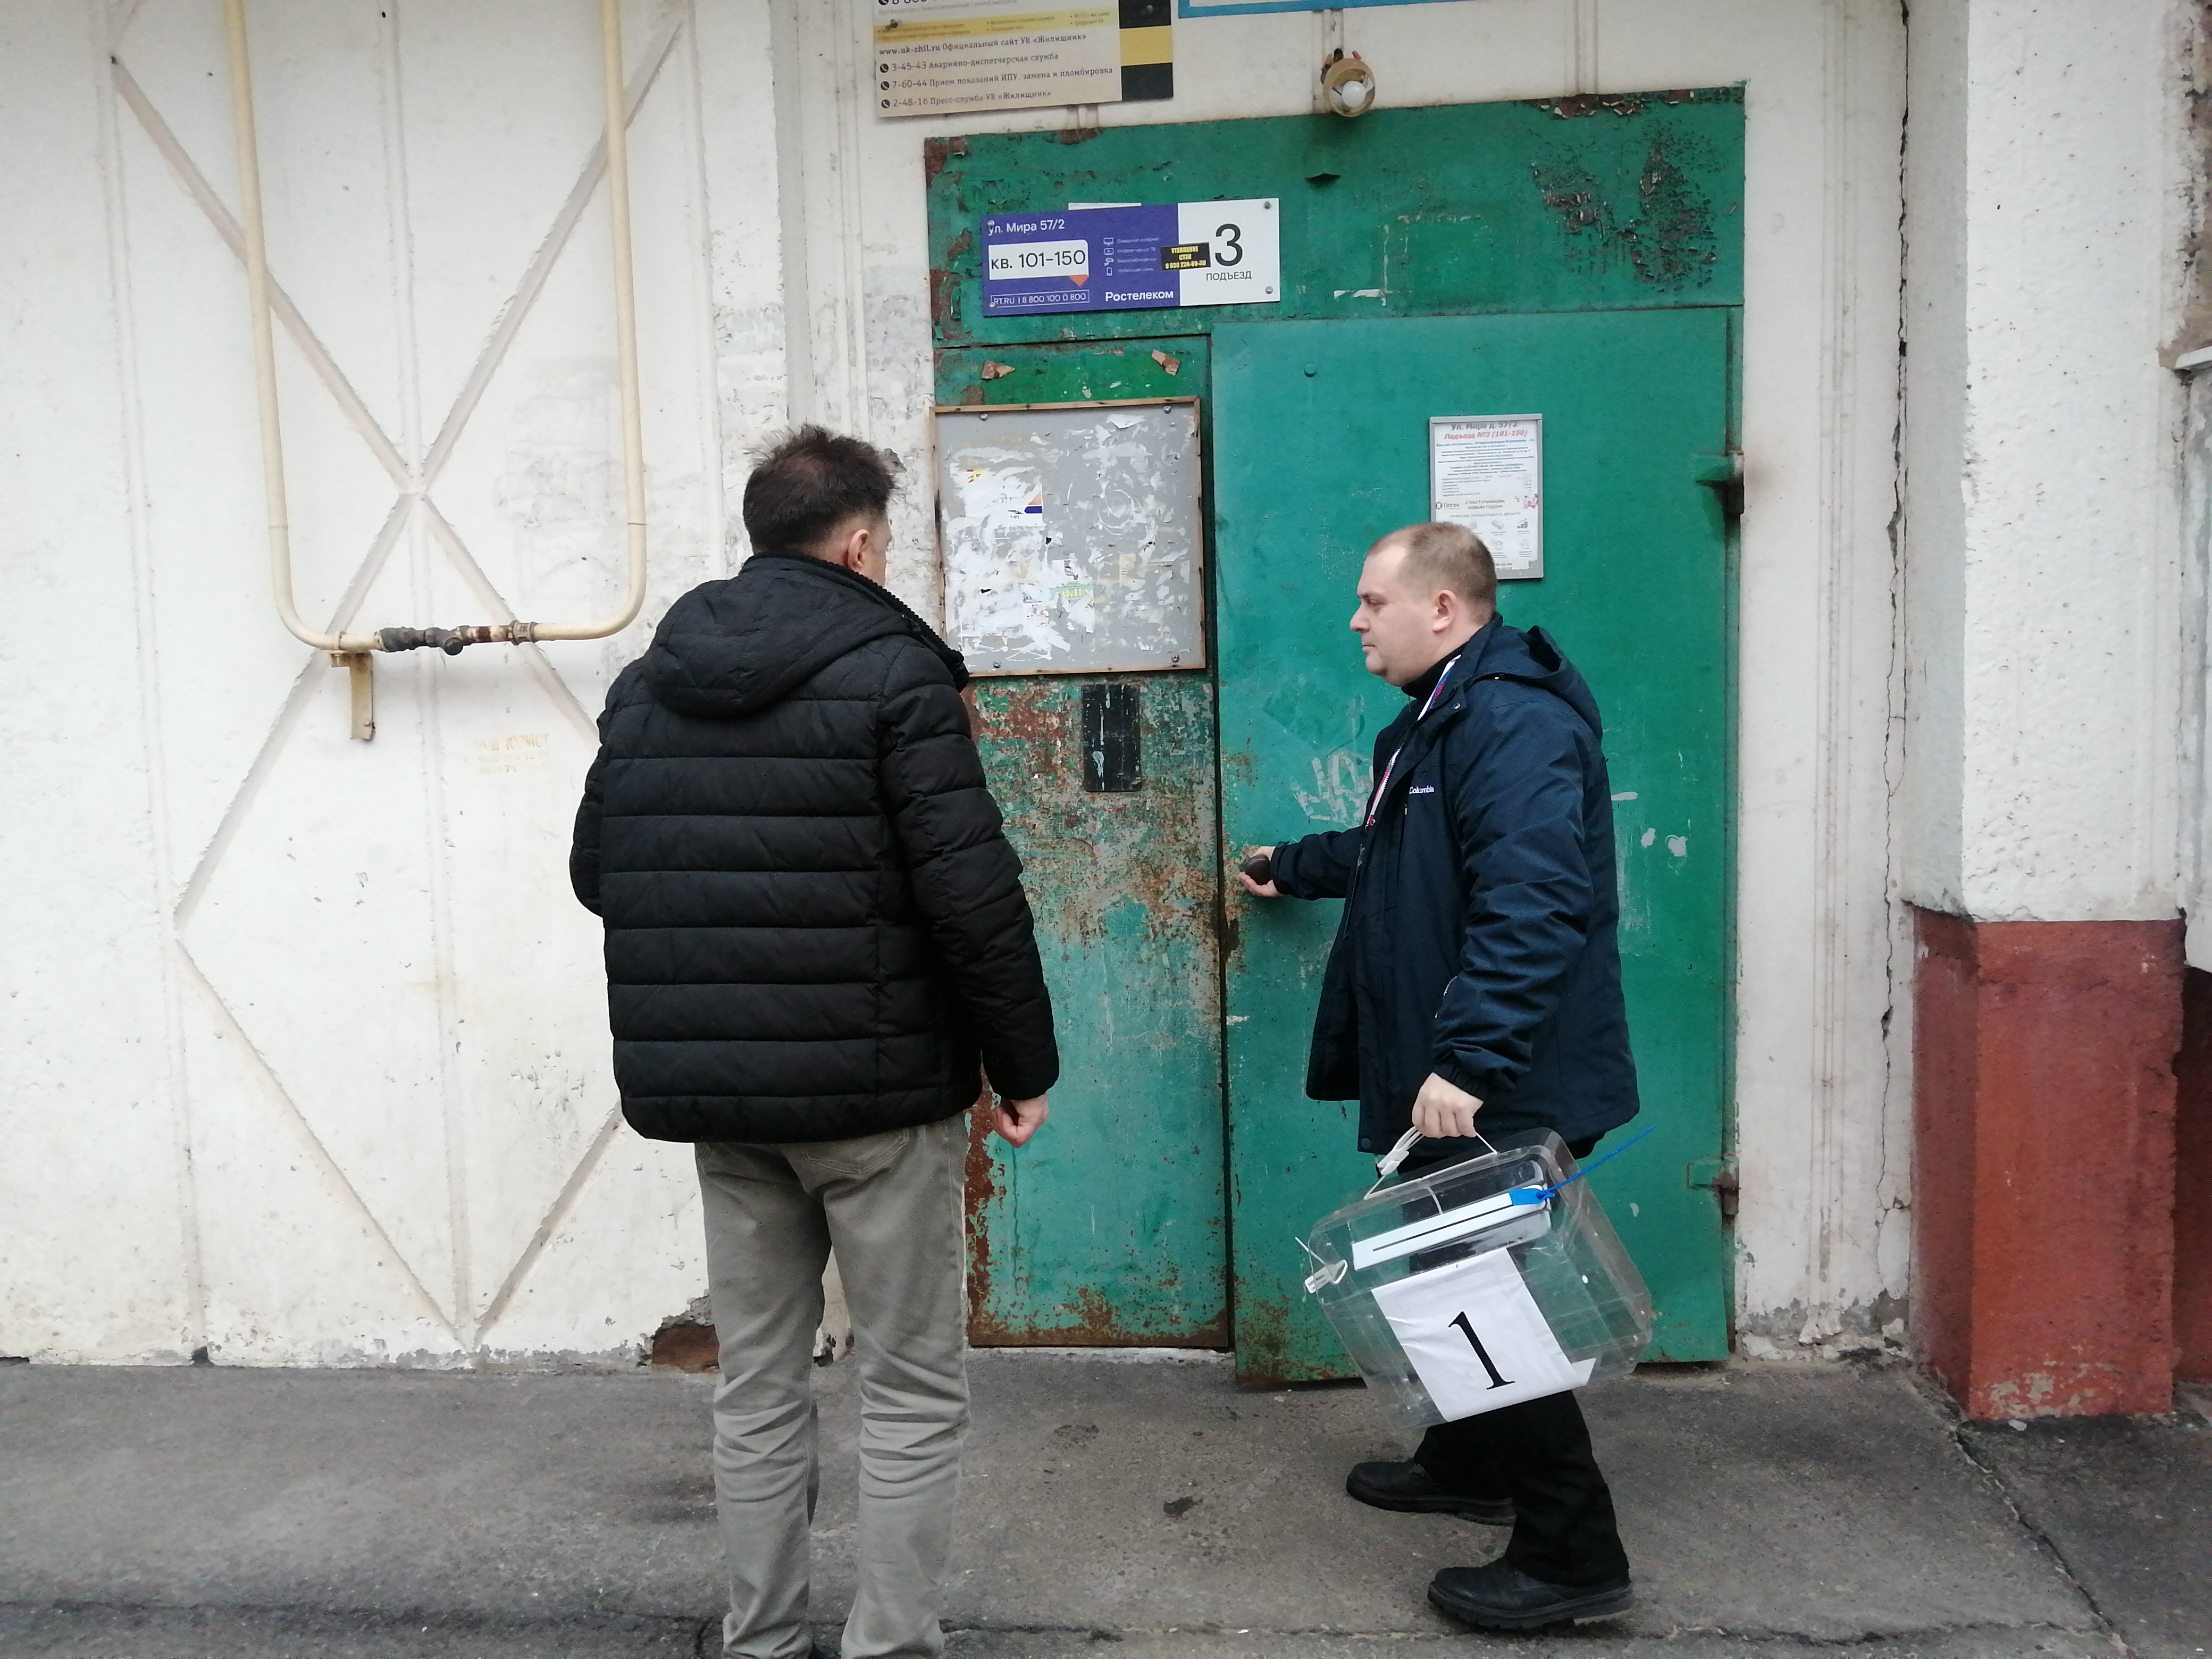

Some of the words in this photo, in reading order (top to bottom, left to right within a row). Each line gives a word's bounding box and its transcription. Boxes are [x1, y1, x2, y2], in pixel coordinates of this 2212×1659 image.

[879, 45, 940, 55] www.uk-zhil.ru
[942, 40, 999, 52] Официальный
[1033, 34, 1086, 44] «Жилищник»
[892, 61, 927, 71] 3-45-43
[929, 55, 1028, 70] Аварийно-диспетчерская
[1030, 52, 1059, 63] служба
[892, 79, 927, 88] 7-60-44
[929, 79, 955, 87] Прием
[957, 74, 999, 85] показаний
[1060, 67, 1113, 78] пломбировка
[893, 97, 928, 107] 2-48-16
[930, 95, 983, 106] Пресс-служба
[998, 91, 1051, 100] «Жилищник»
[1006, 222, 1037, 234] Мира
[1040, 219, 1065, 230] 57/2
[1214, 223, 1243, 266] 3
[991, 258, 1013, 270] кв.
[1018, 249, 1086, 268] 101-150
[1206, 271, 1252, 281] ПОДЪЕЗД
[1105, 290, 1174, 301] Ростелеком
[1492, 430, 1528, 438] (101-150)
[1409, 785, 1435, 794] Columbia
[1447, 1311, 1516, 1390] 1
